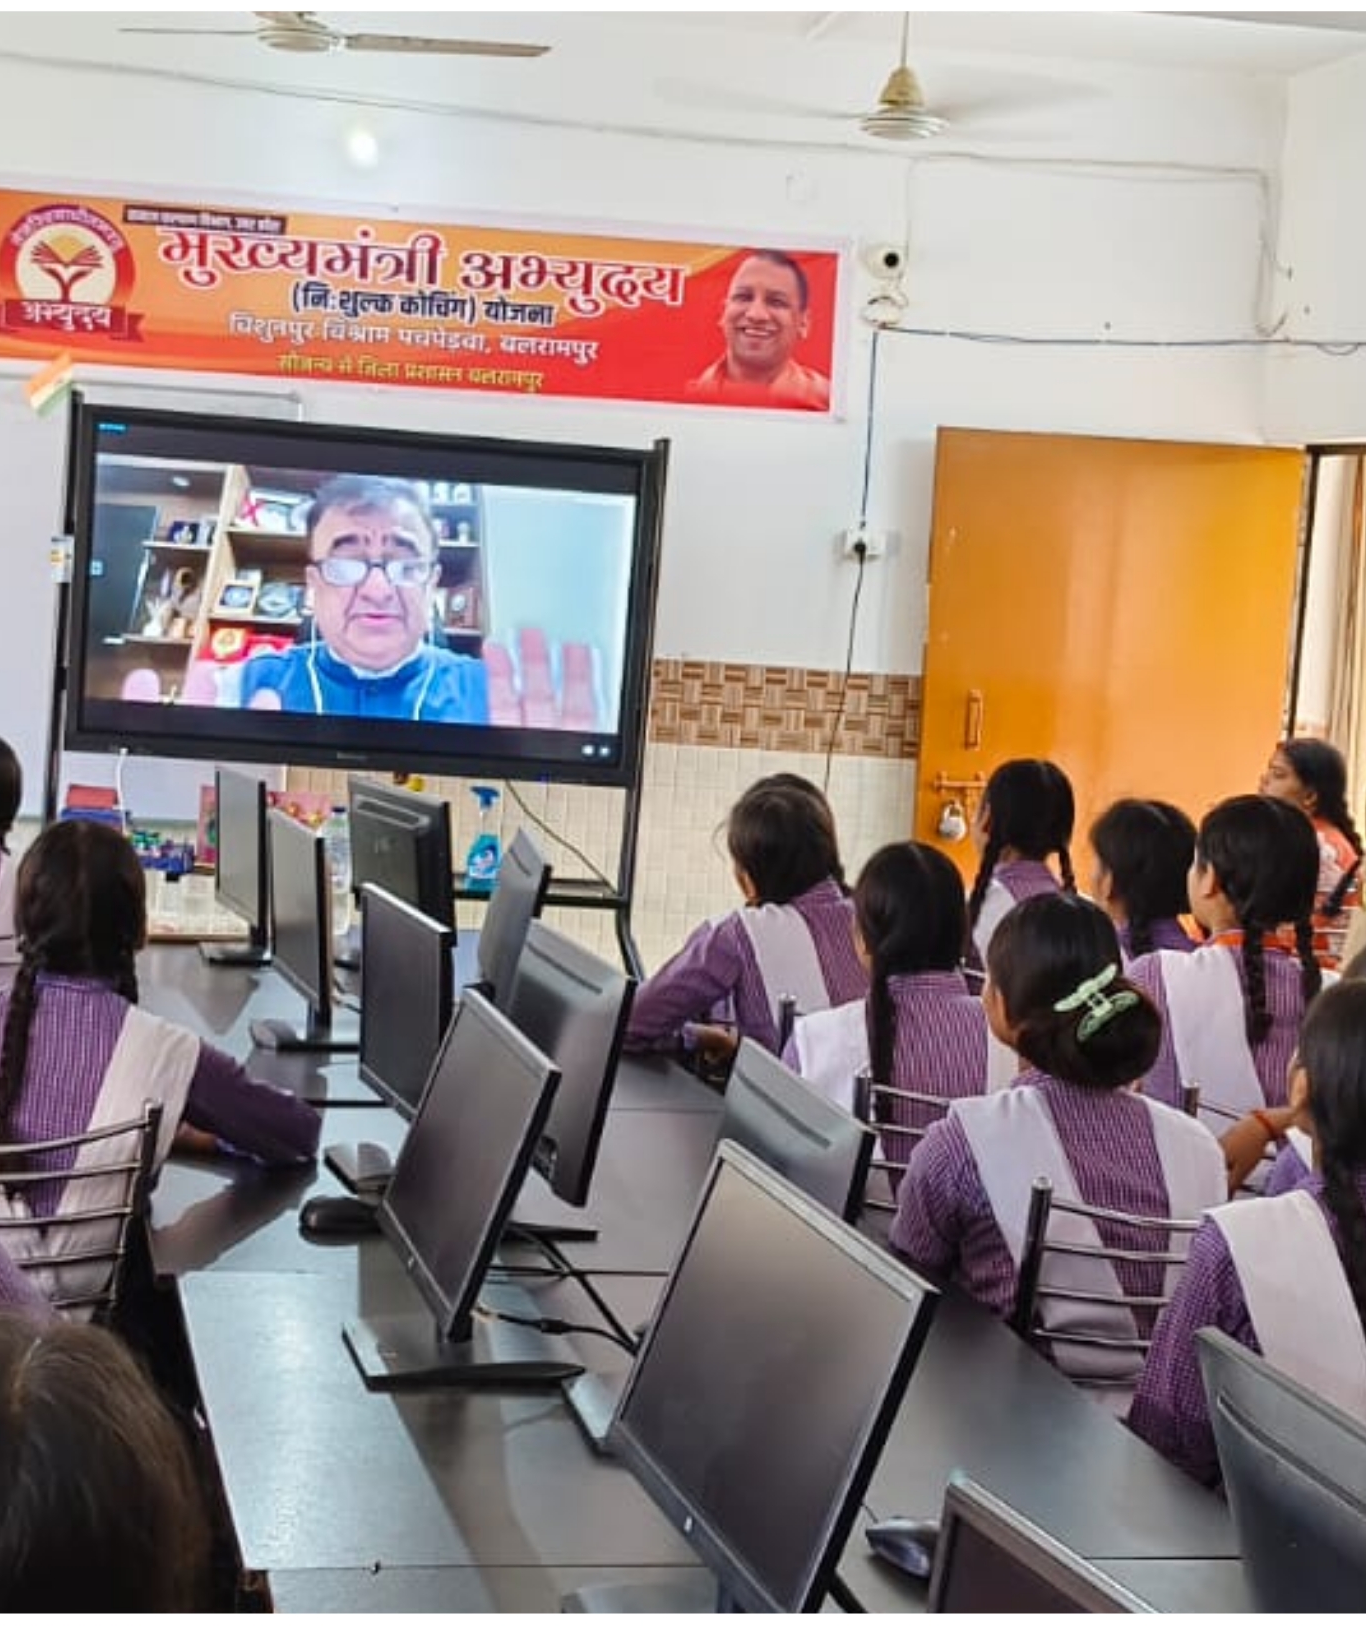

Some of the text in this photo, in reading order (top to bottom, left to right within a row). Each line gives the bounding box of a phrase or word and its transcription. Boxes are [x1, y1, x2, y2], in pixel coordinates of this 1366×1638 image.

[157, 225, 691, 319] मुख्यमंत्री अभ्युदय
[401, 289, 475, 324] कोचिंग)
[483, 299, 554, 326] योजना
[499, 335, 599, 365] बलरामपुर
